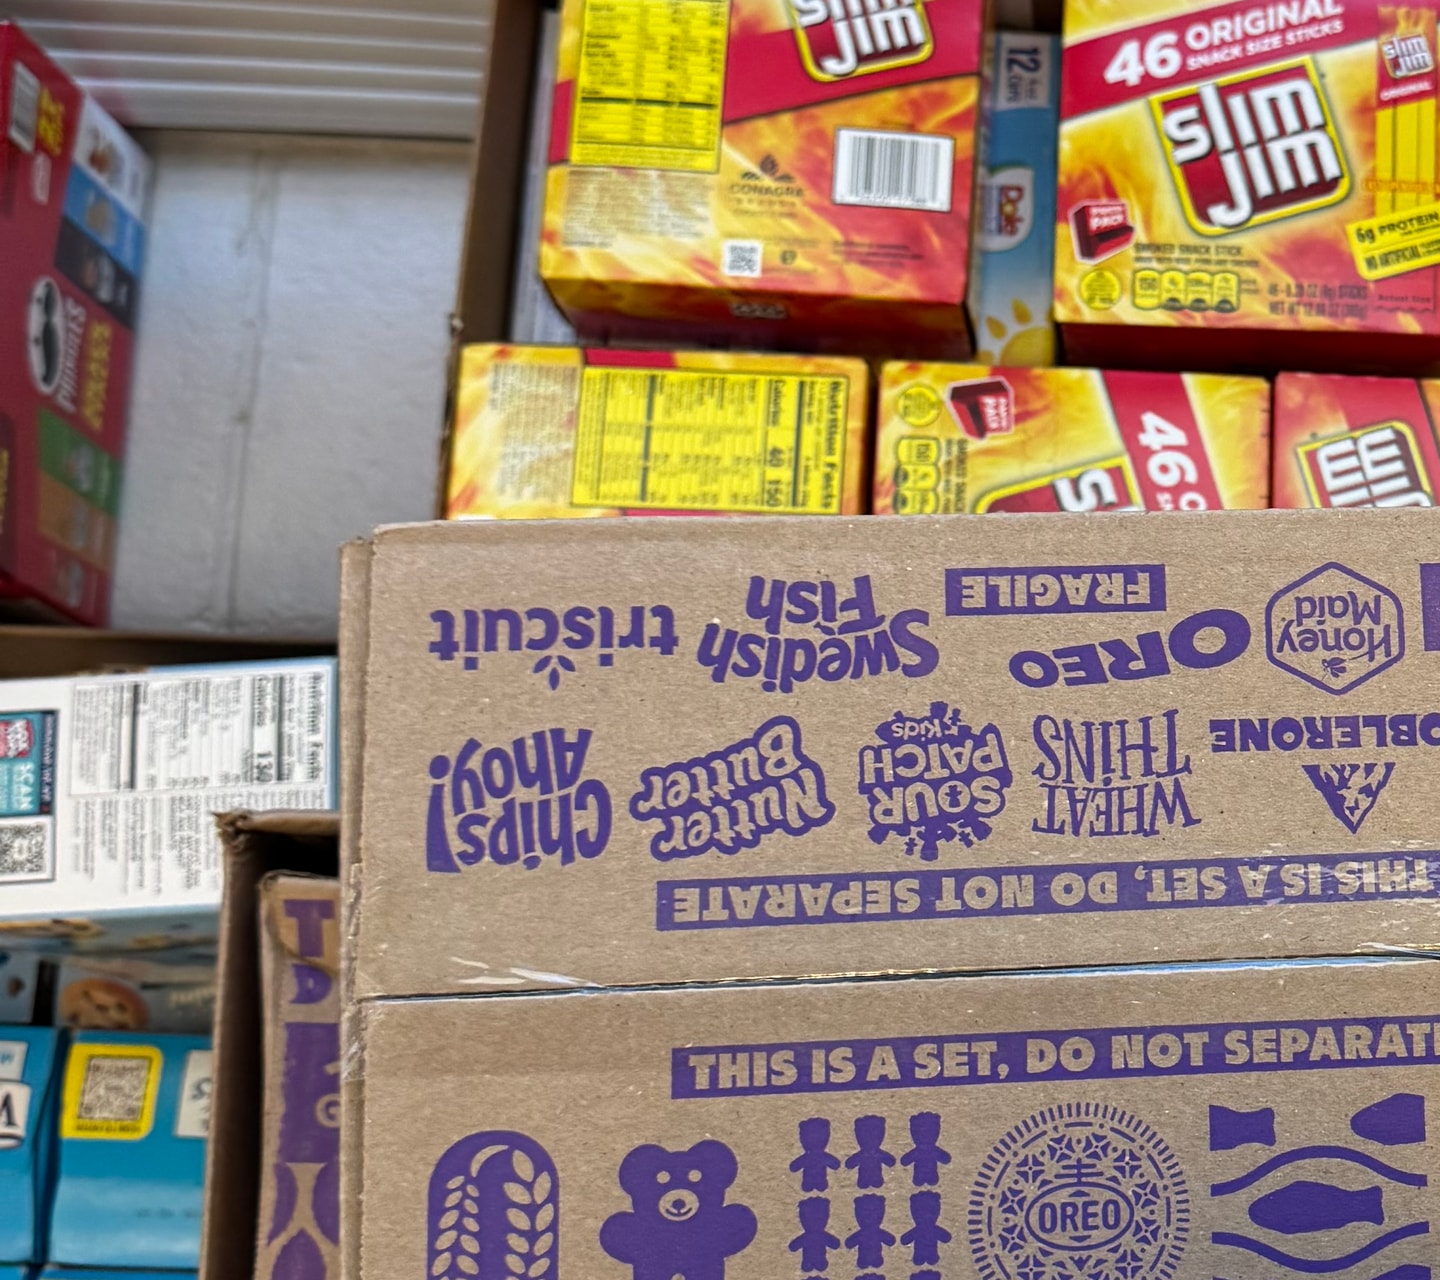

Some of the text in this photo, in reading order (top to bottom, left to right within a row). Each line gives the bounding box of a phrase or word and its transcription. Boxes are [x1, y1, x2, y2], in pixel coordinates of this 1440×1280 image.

[1102, 31, 1182, 87] 46
[1186, 20, 1345, 71] SNACK SIZE STICKS
[1378, 211, 1440, 237] PROTEIN
[1138, 411, 1198, 489] 46
[746, 574, 888, 636] Fish
[961, 572, 1150, 608] FRAGILE
[1292, 588, 1384, 626] Maid
[428, 604, 680, 672] triscuit
[698, 608, 940, 694] Swedish
[1009, 608, 1252, 689] OREO
[1277, 621, 1391, 660] Honey
[651, 722, 803, 806] Butter
[865, 741, 1003, 786] PATCH
[651, 766, 829, 863] Nutter
[873, 775, 1002, 825] SOUR
[1031, 775, 1202, 838] WHEAT
[671, 855, 1432, 922] THIS IS SET, DO NOT SEPARATE
[688, 1048, 799, 1093] THIS
[811, 1047, 853, 1087] IS
[914, 1041, 1009, 1082] SET,
[1025, 1036, 1098, 1075] DO
[1111, 1030, 1217, 1072] NOT
[1037, 1195, 1124, 1232] OREO
